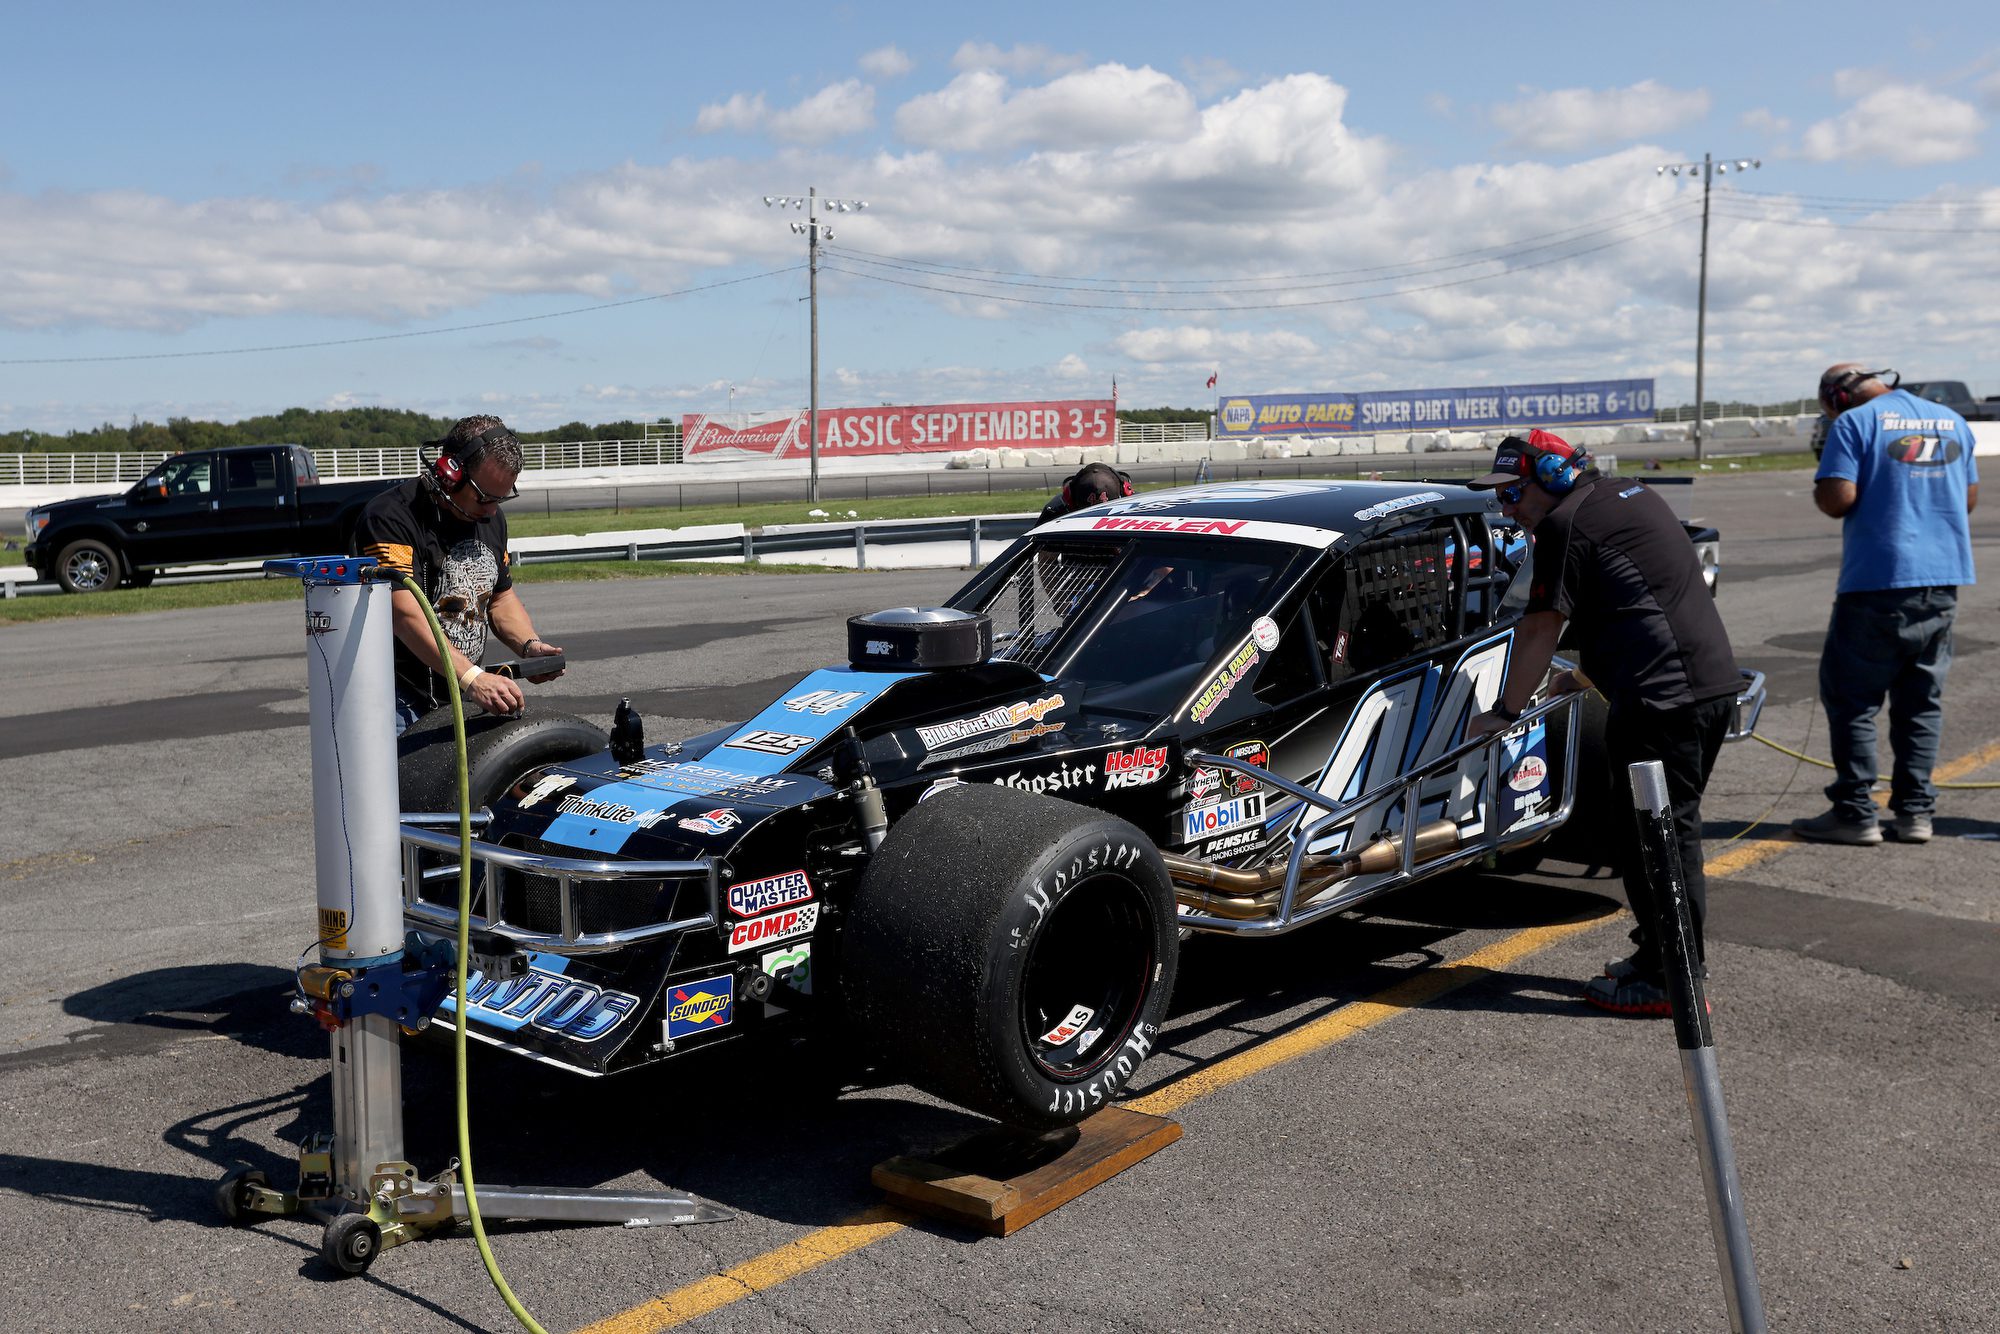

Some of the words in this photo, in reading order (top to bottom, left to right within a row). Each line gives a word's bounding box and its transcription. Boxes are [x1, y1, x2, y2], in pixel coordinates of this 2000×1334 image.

[1226, 406, 1250, 423] NAPA
[1258, 405, 1300, 424] AUTO
[1305, 403, 1356, 422] PARTS
[1362, 401, 1411, 424] SUPER
[1414, 399, 1450, 421] DIRT
[1455, 397, 1499, 419] WEEK
[1506, 393, 1599, 418] OCTOBER
[1605, 389, 1650, 413] 6-10
[699, 428, 785, 447] Budweiser
[793, 413, 902, 450] CASSIC
[911, 409, 1061, 444] SEPTEMBER
[1069, 408, 1107, 438] 3-5
[1093, 518, 1248, 535] WHELEN
[784, 690, 869, 716] 44
[1008, 695, 1064, 725] Engines
[1192, 680, 1223, 721] JAMES
[1105, 746, 1168, 773] Holley
[1235, 743, 1261, 757] NASCAR
[639, 758, 798, 787] HARSHAW
[1105, 767, 1160, 791] MSD
[557, 794, 636, 824] ThinkLite
[1188, 801, 1240, 835] Mobil
[1206, 828, 1260, 854] PENSKE
[1212, 849, 1233, 862] RACING
[1233, 842, 1256, 856] SHOCKS
[731, 873, 804, 907] QUARTER
[745, 885, 808, 913] MASTER
[732, 912, 797, 945] COMP
[777, 923, 808, 938] CAMS
[672, 996, 728, 1021] SUNOCO
[1069, 1010, 1089, 1028] LS
